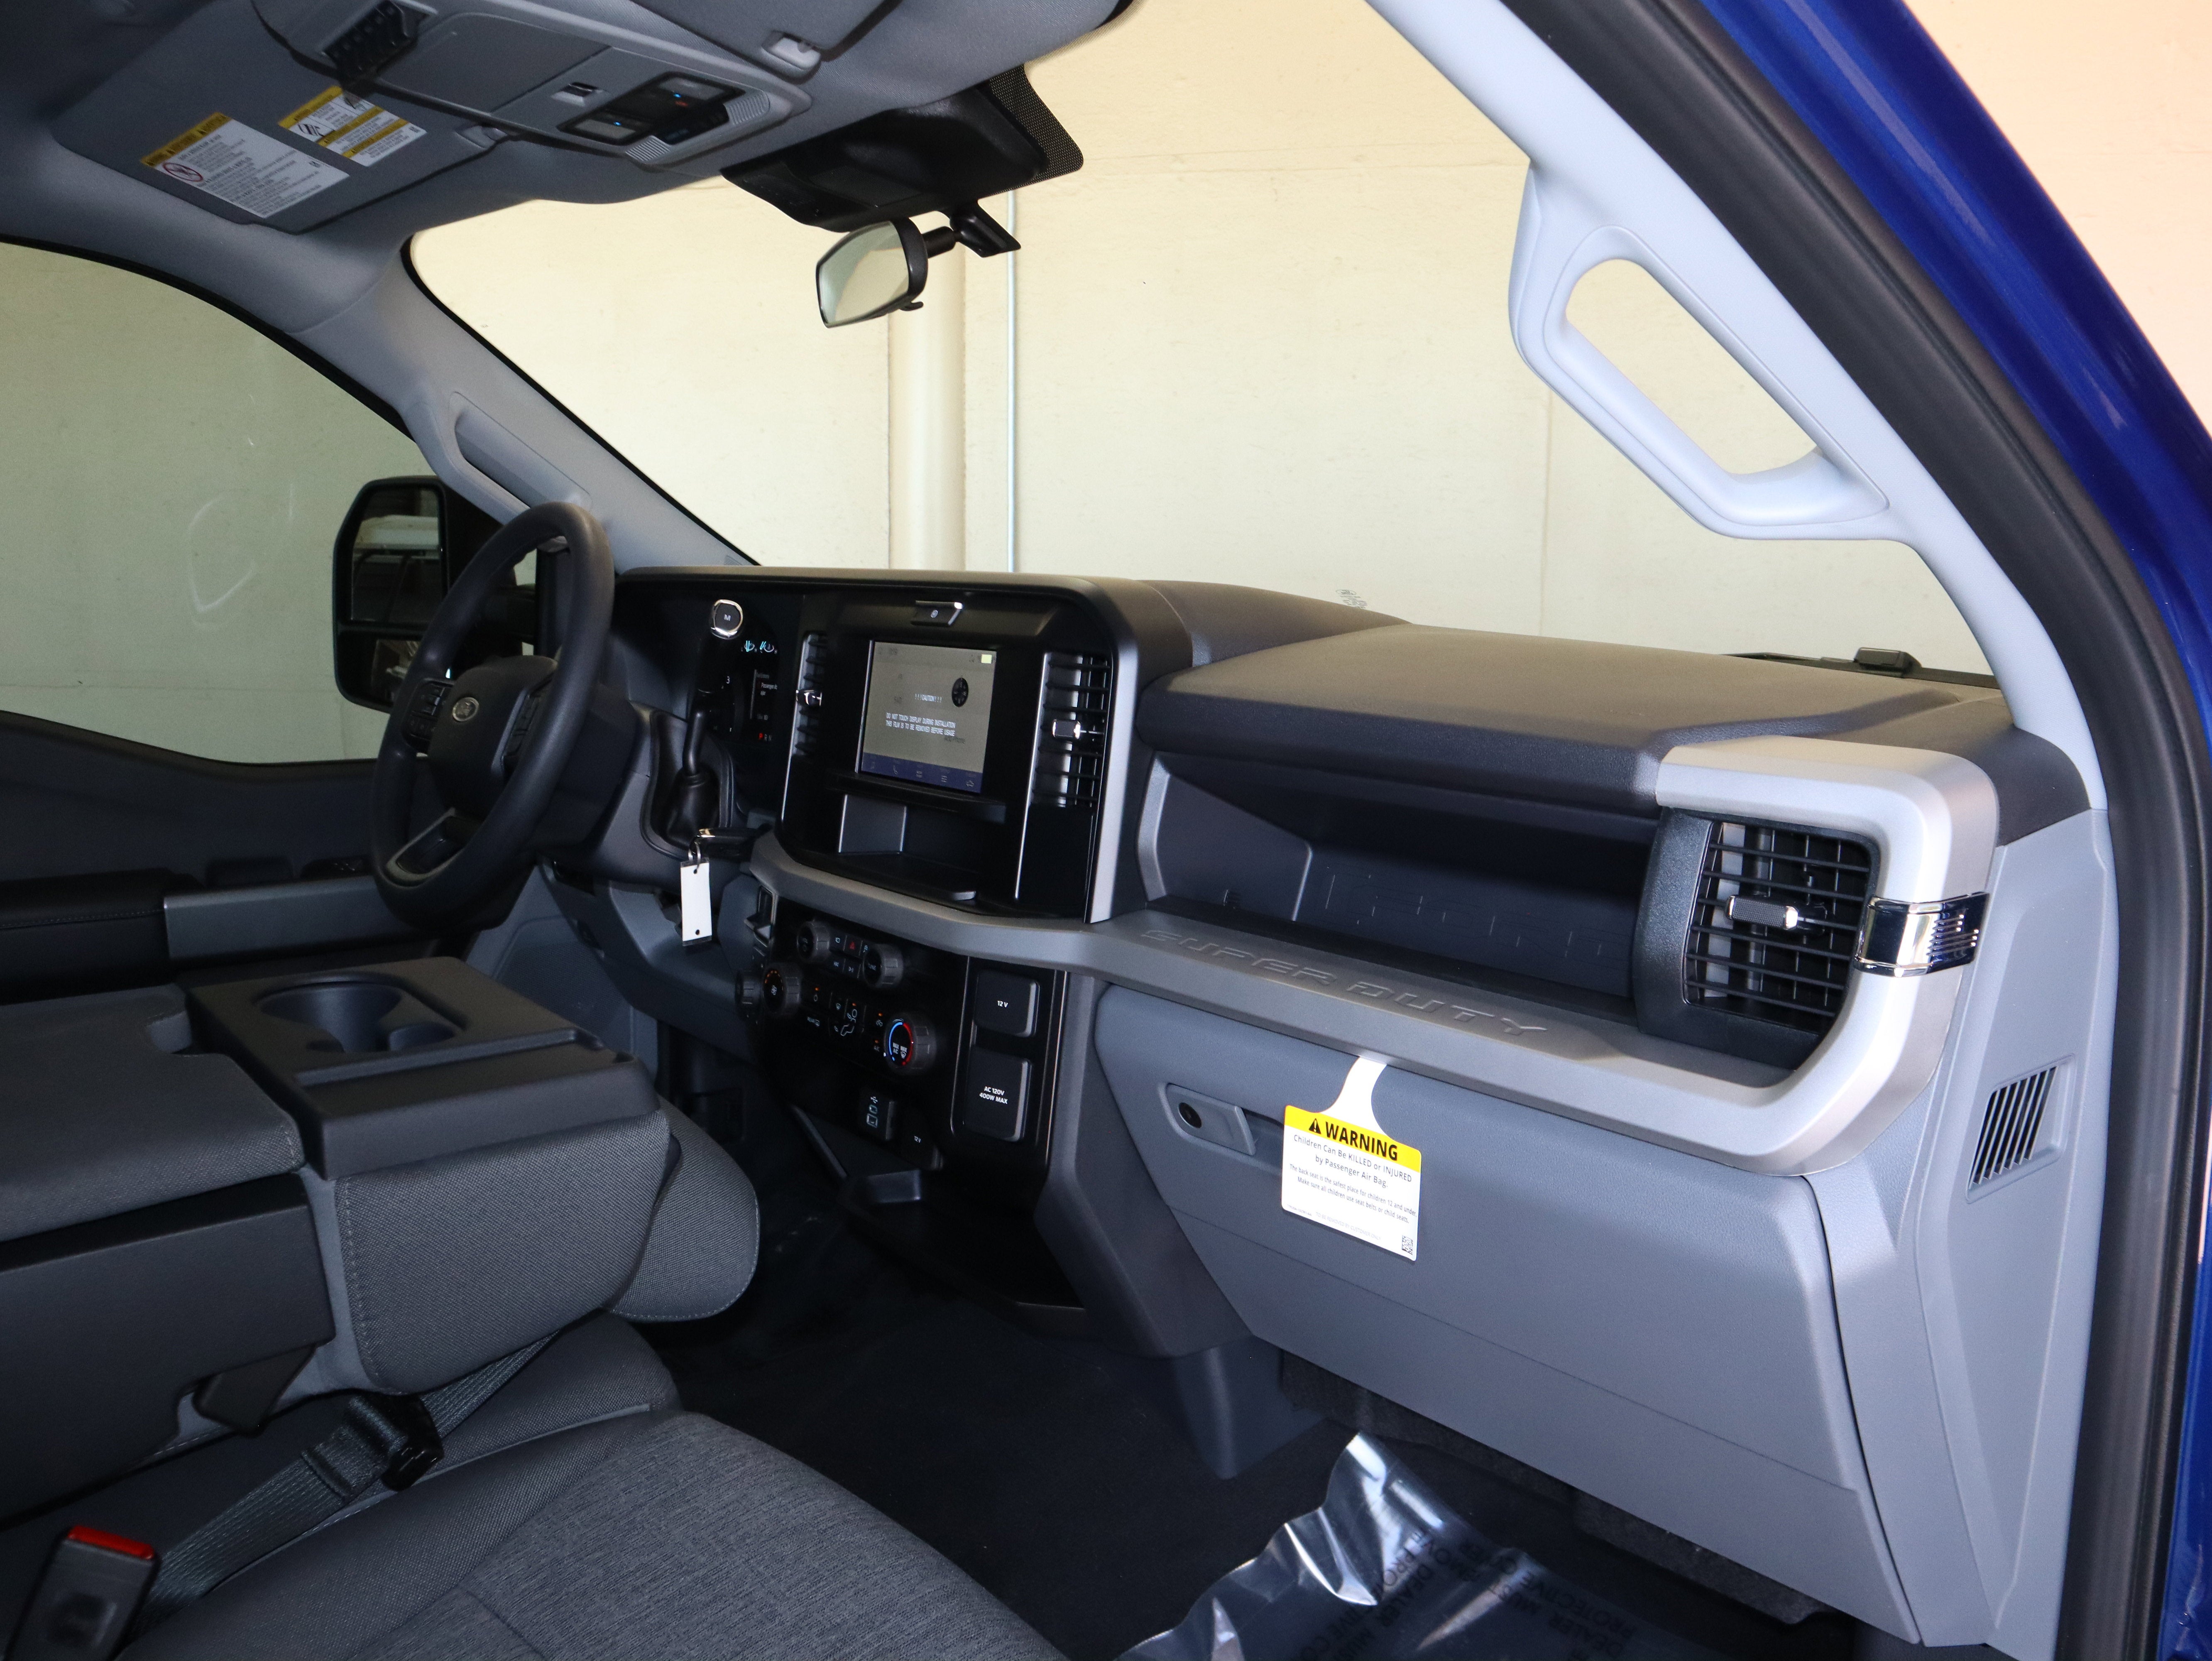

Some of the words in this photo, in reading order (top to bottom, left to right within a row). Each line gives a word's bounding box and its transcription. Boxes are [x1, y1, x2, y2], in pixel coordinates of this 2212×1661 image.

[1140, 928, 1338, 987] SUPER
[1346, 980, 1548, 1036] DUTY
[979, 1092, 995, 1101] 400W
[995, 1096, 1008, 1105] MAX
[992, 1088, 1005, 1096] 120V
[1294, 1134, 1321, 1150] Children
[1324, 1145, 1336, 1155] Can
[1338, 1149, 1346, 1159] Be
[1348, 1153, 1372, 1167] KILLED
[1383, 1165, 1412, 1182] INJURED
[1325, 1121, 1398, 1161] WARNING
[1298, 1167, 1308, 1176] back
[1309, 1171, 1319, 1180] seat
[1333, 1180, 1346, 1189] safest
[1347, 1185, 1358, 1194] place
[1368, 1193, 1386, 1204] children
[1404, 1206, 1417, 1218] under.
[1315, 1155, 1323, 1165] by
[1325, 1158, 1360, 1176] Passenger
[1361, 1172, 1371, 1181] Air
[1373, 1176, 1388, 1188] Bag.
[1298, 1176, 1309, 1186] Make
[1327, 1188, 1345, 1199] children
[1355, 1198, 1365, 1207] seat
[1366, 1202, 1376, 1211] belts
[1384, 1208, 1395, 1218] child
[1396, 1213, 1409, 1223] seats.
